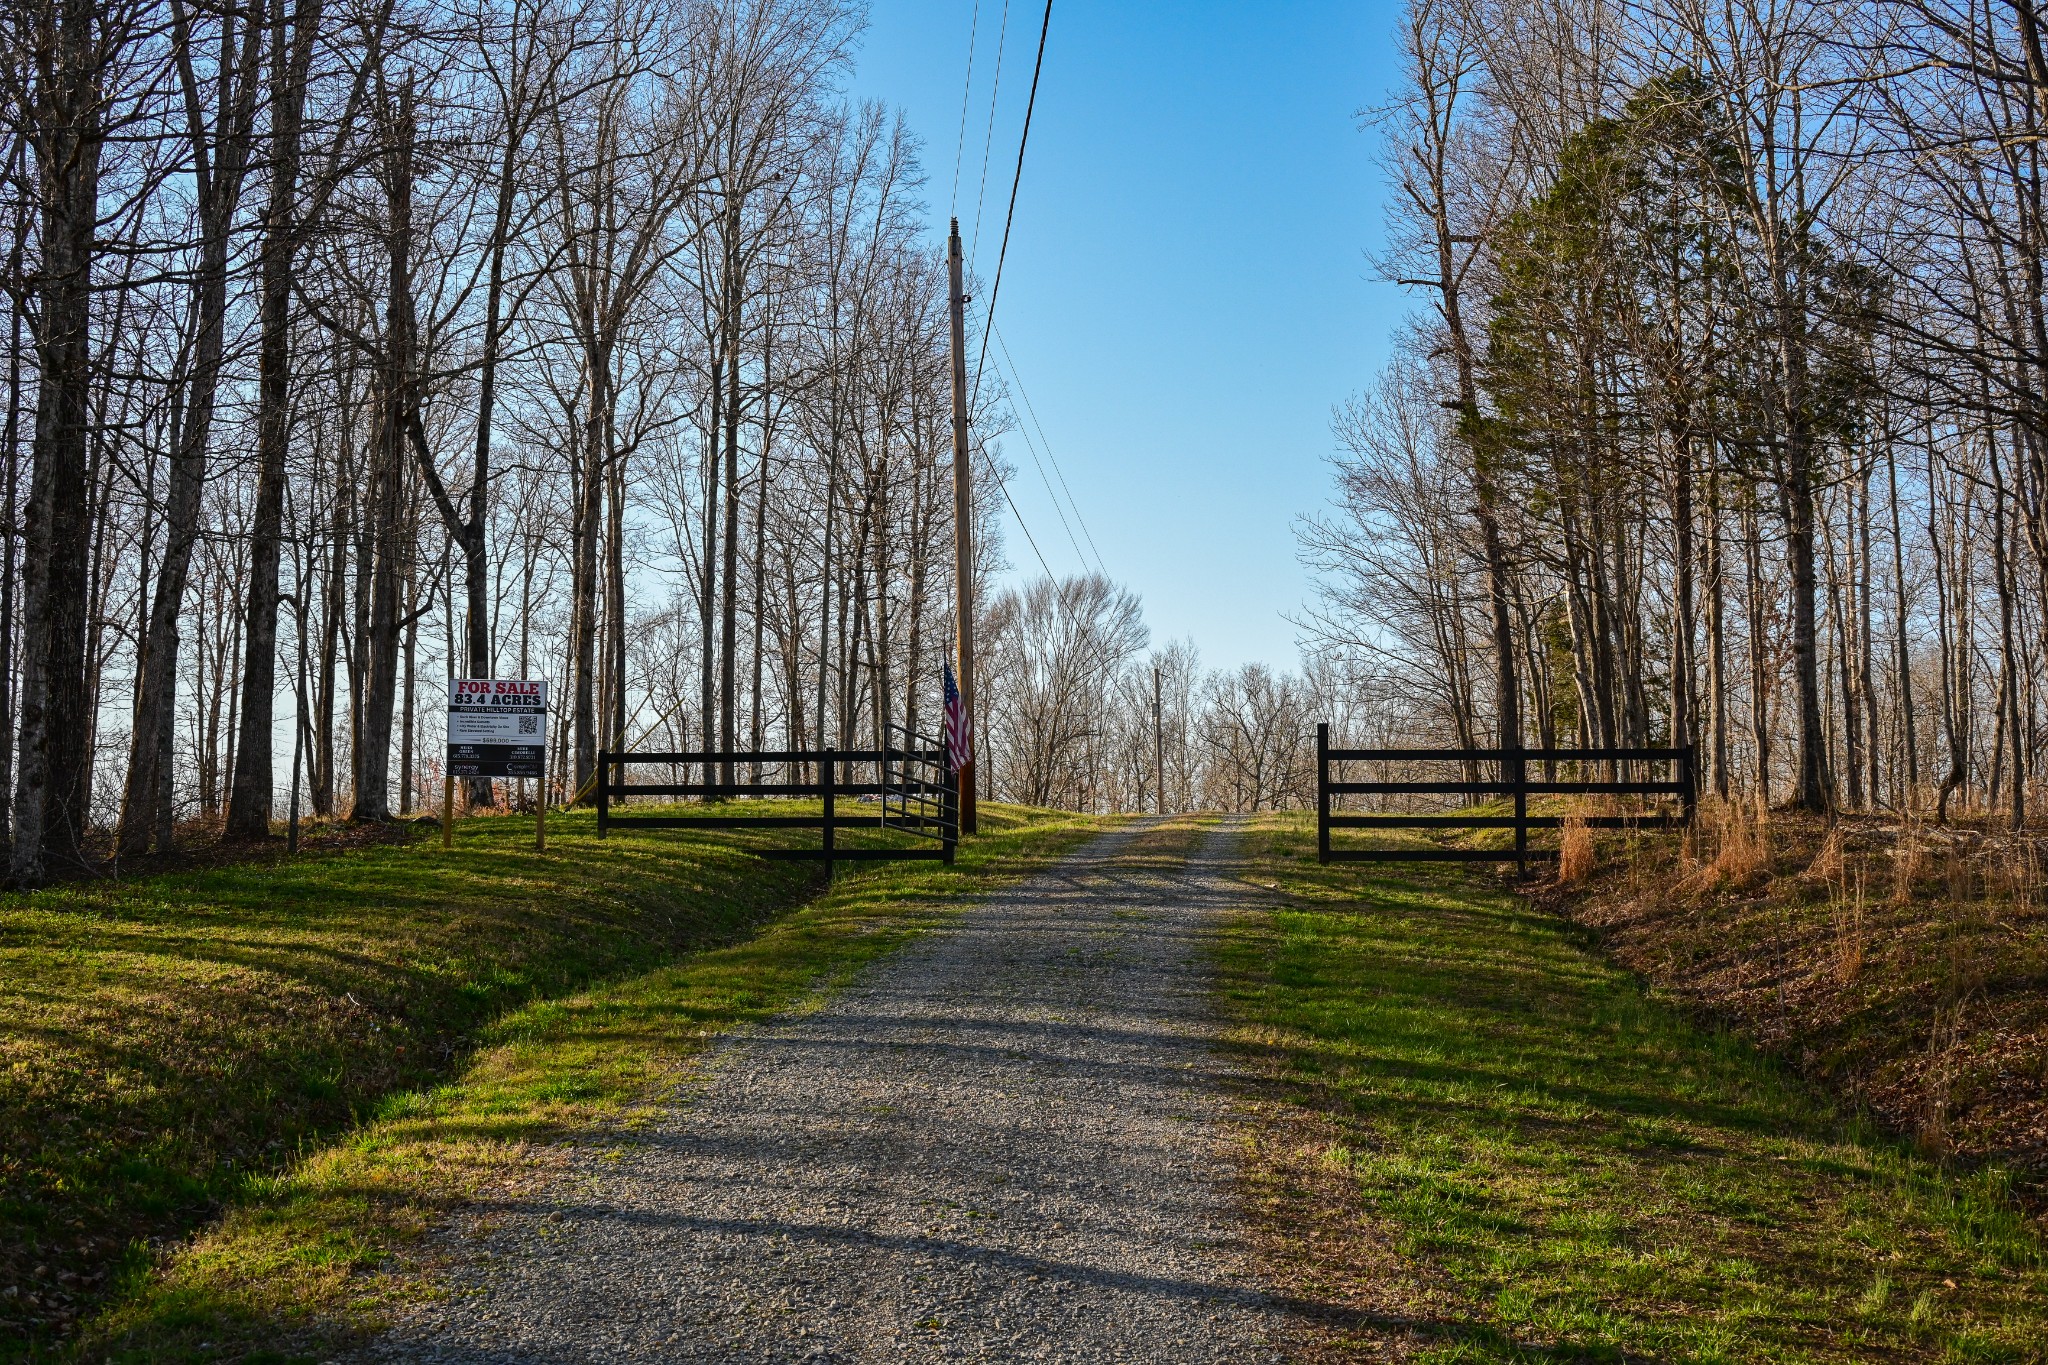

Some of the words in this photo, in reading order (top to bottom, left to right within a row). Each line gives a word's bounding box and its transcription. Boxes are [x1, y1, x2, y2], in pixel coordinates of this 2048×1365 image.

[458, 682, 491, 694] FOR
[495, 682, 539, 695] SALE
[454, 693, 486, 705] 83.4
[491, 694, 541, 706] ACRES
